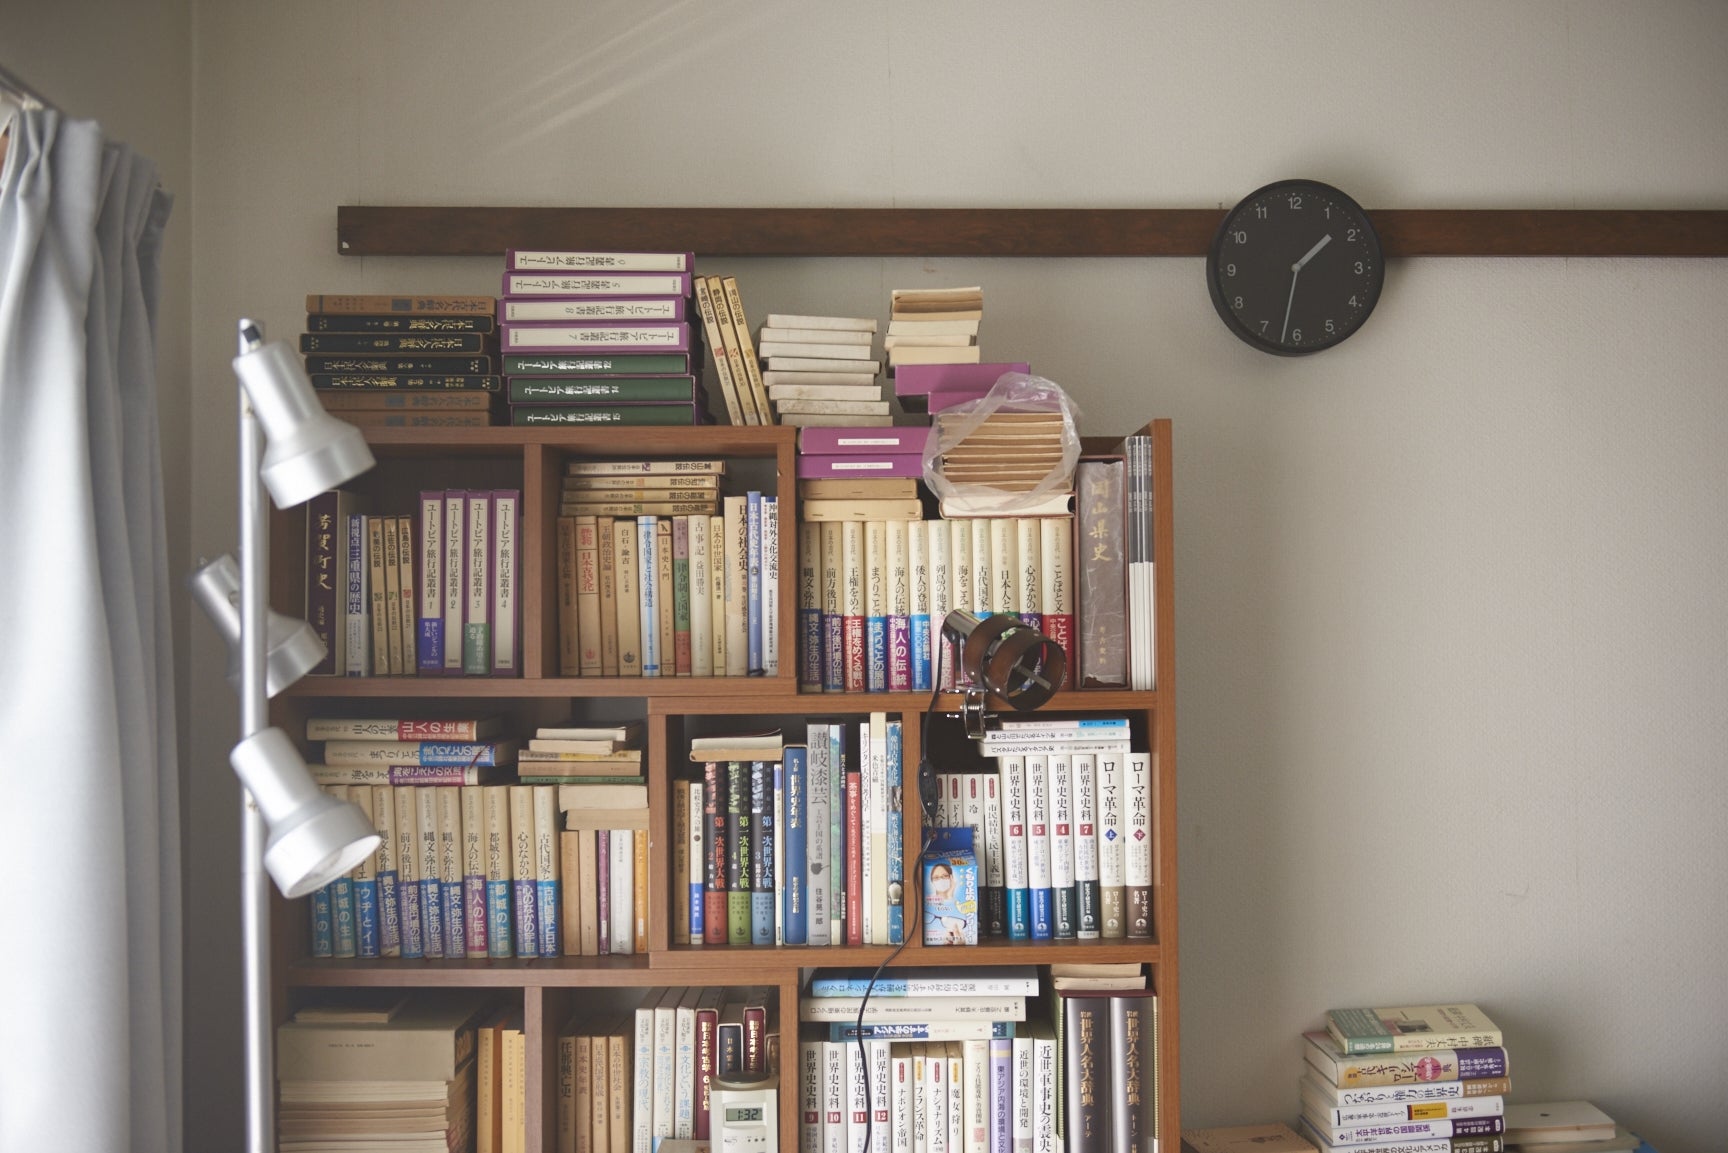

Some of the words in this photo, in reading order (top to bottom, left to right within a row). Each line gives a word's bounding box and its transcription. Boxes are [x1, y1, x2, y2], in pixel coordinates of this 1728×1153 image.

[1256, 207, 1267, 219] 11
[1288, 197, 1302, 209] 12
[1324, 208, 1330, 219] 1
[1233, 231, 1247, 244] 10
[1347, 229, 1356, 241] 2
[1227, 264, 1236, 276] 9
[1354, 262, 1363, 274] 3
[1234, 297, 1243, 309] 8
[1348, 296, 1357, 307] 4
[1260, 321, 1269, 332] 7
[1292, 329, 1302, 341] 6
[1325, 320, 1334, 332] 5
[768, 504, 778, 580] 沖縄対外文化交流史
[1025, 564, 1036, 613] 心のなかの
[1053, 564, 1064, 614] ことばと文
[895, 618, 907, 685] 海人の伝統
[401, 721, 470, 734] 山人の生業
[1009, 762, 1021, 822] 世界史史料
[1032, 762, 1044, 822] 世界史史料
[1056, 762, 1067, 822] 世界史史料
[1080, 762, 1092, 822] 世界史史料
[1103, 762, 1118, 825] ローマ革命
[1132, 762, 1147, 825] ローマ革命
[1013, 826, 1019, 834] 6
[1036, 826, 1042, 834] 5
[1060, 826, 1065, 834] 4
[1083, 826, 1089, 834] 7
[359, 887, 375, 956] ウチとイエ
[449, 887, 464, 954] 縄文・弥生の生活
[472, 878, 485, 946] 海人の伝統
[810, 1006, 878, 1014] ロシア極東の民族古学
[806, 1050, 817, 1109] 世界史史料
[829, 1050, 840, 1109] 世界史史料
[876, 1048, 887, 1108] 世界史史料
[1080, 1018, 1095, 1107] 世界人名大辞典
[1126, 1018, 1141, 1107] 世界人名大辞典
[951, 1089, 961, 1137] 魔女狩り
[1019, 1050, 1029, 1129] 近世の環境と開発
[1344, 1083, 1460, 1105] つながりと権力の世界史
[738, 1109, 759, 1120] 1:32
[829, 1114, 839, 1122] 10
[876, 1112, 887, 1121] 12
[897, 1089, 908, 1148] ナポレオン帝国
[915, 1088, 924, 1141] フランス革命
[934, 1089, 946, 1146] ナショナリズム
